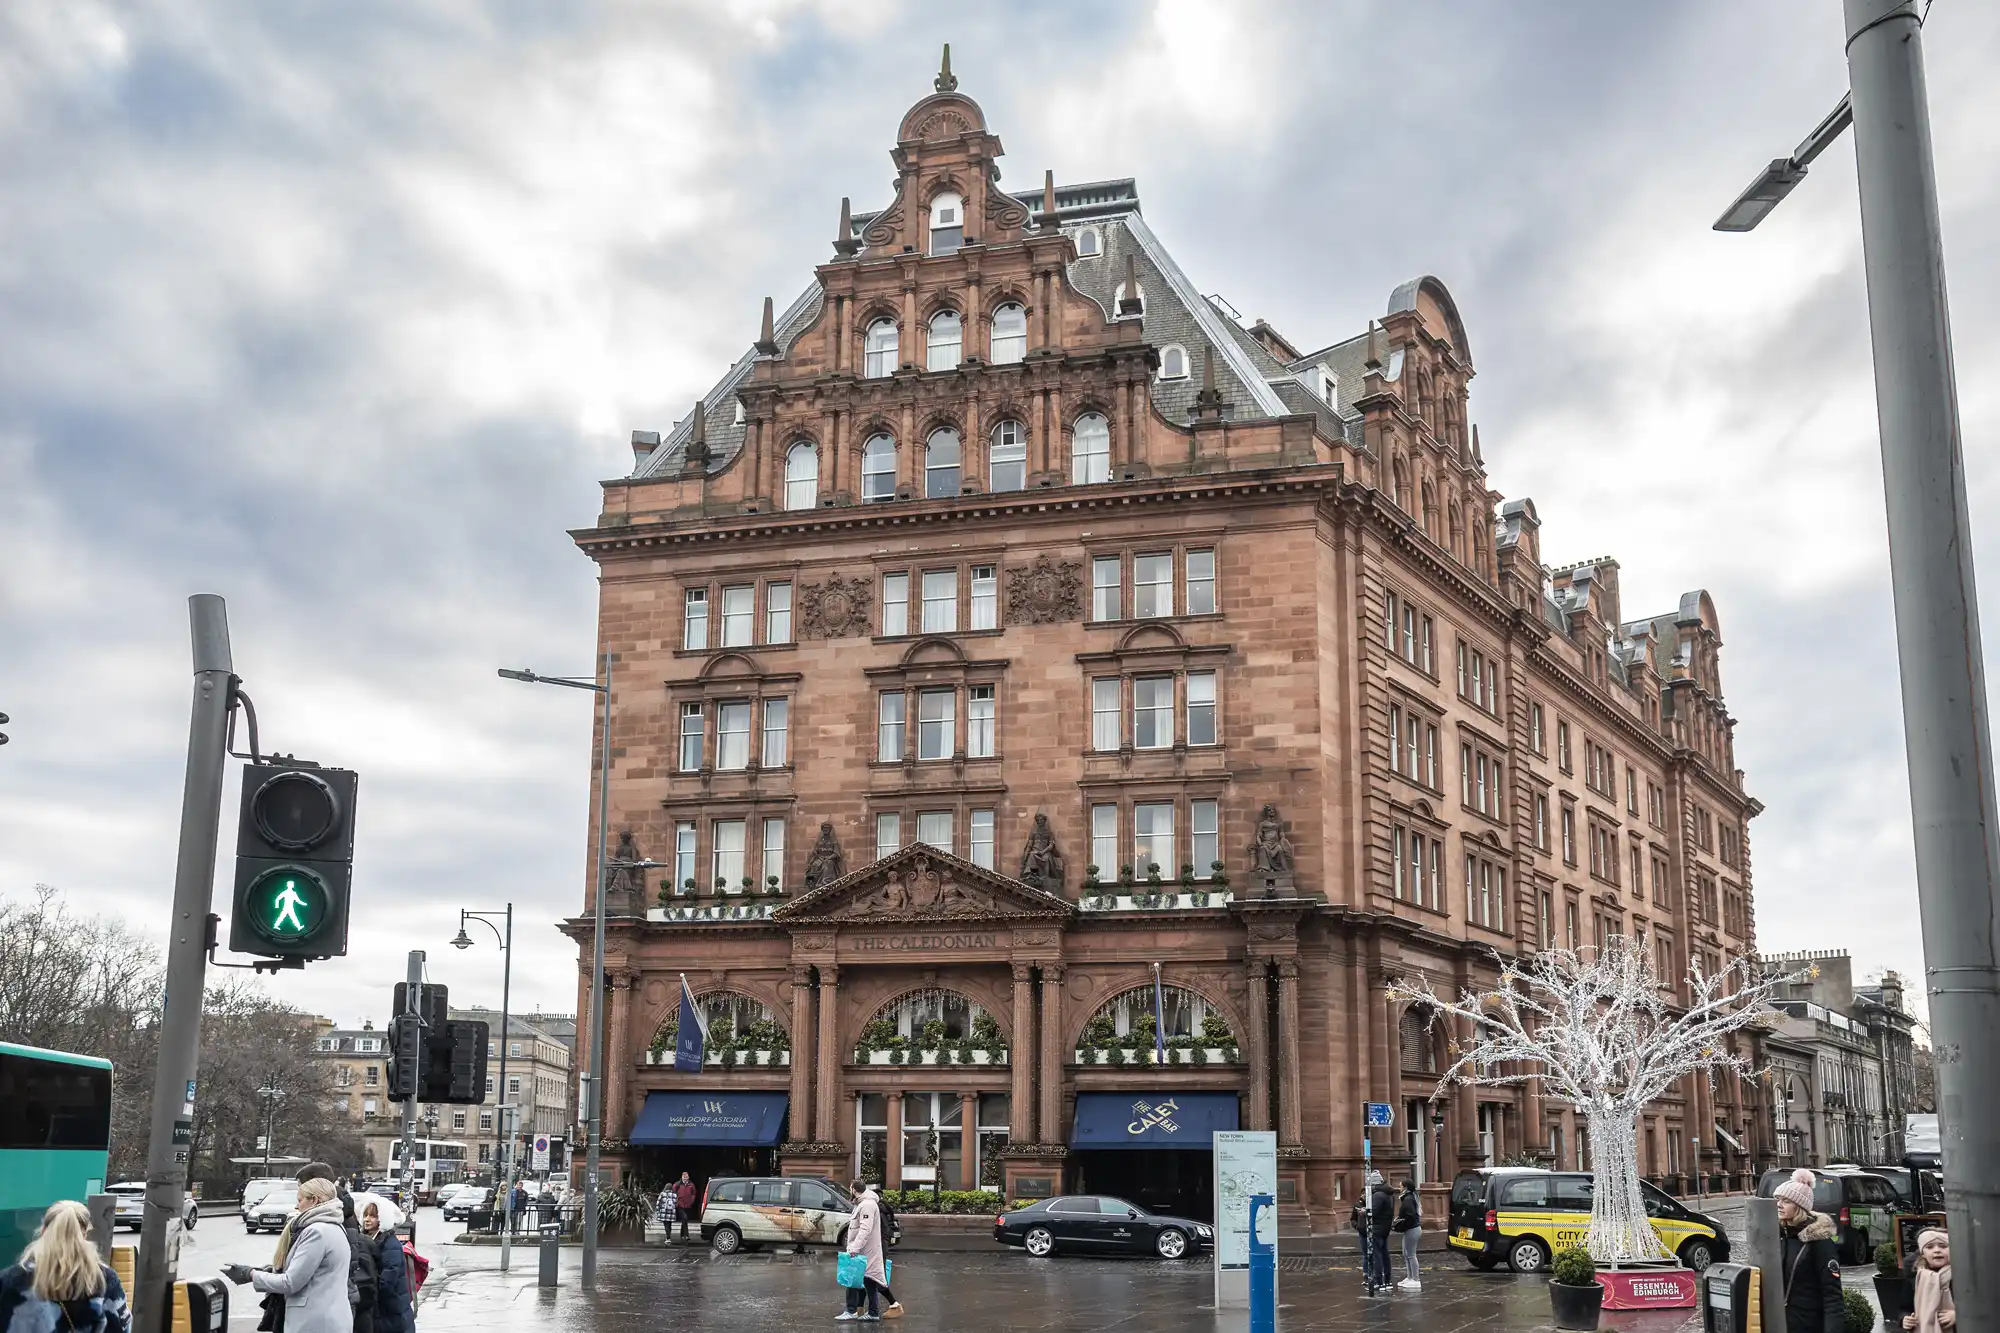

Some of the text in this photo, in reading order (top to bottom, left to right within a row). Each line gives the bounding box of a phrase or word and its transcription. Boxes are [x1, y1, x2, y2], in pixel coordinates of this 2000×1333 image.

[853, 935, 996, 950] THE CALEDONIAN
[1134, 1100, 1151, 1113] THE
[1127, 1097, 1179, 1134] CALEY
[1160, 1119, 1178, 1133] BAR
[1557, 1231, 1581, 1240] CITY
[1633, 1282, 1679, 1290] ESSENTIAL
[1633, 1288, 1680, 1296] EDINBURGH
